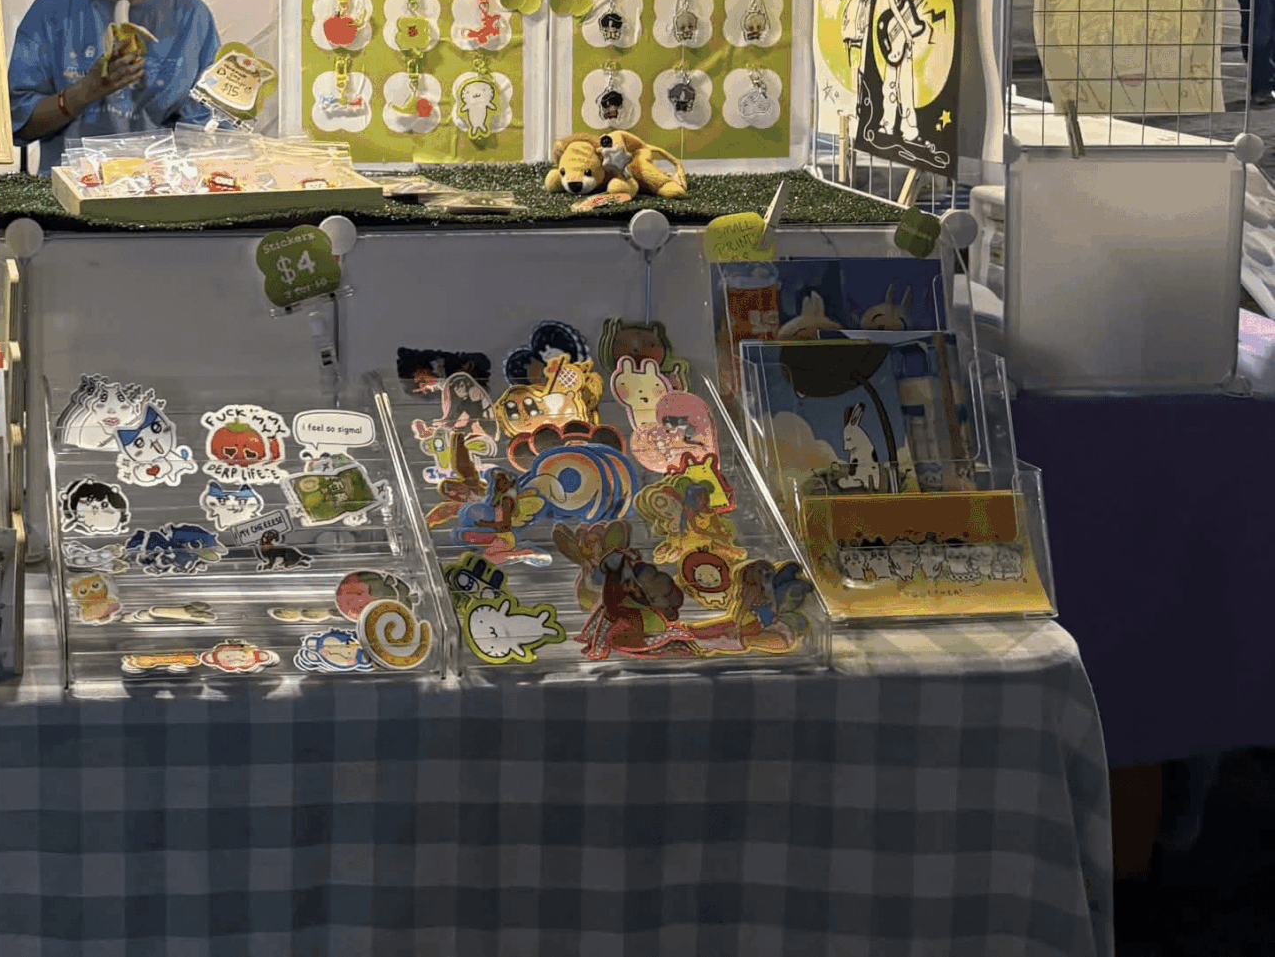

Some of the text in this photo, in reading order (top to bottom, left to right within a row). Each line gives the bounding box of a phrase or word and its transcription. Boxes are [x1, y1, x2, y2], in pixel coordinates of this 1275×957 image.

[262, 232, 315, 255] Stickers
[277, 250, 316, 285] $4
[205, 407, 247, 427] FUCK
[307, 423, 324, 432] feel
[206, 463, 238, 479] DERP
